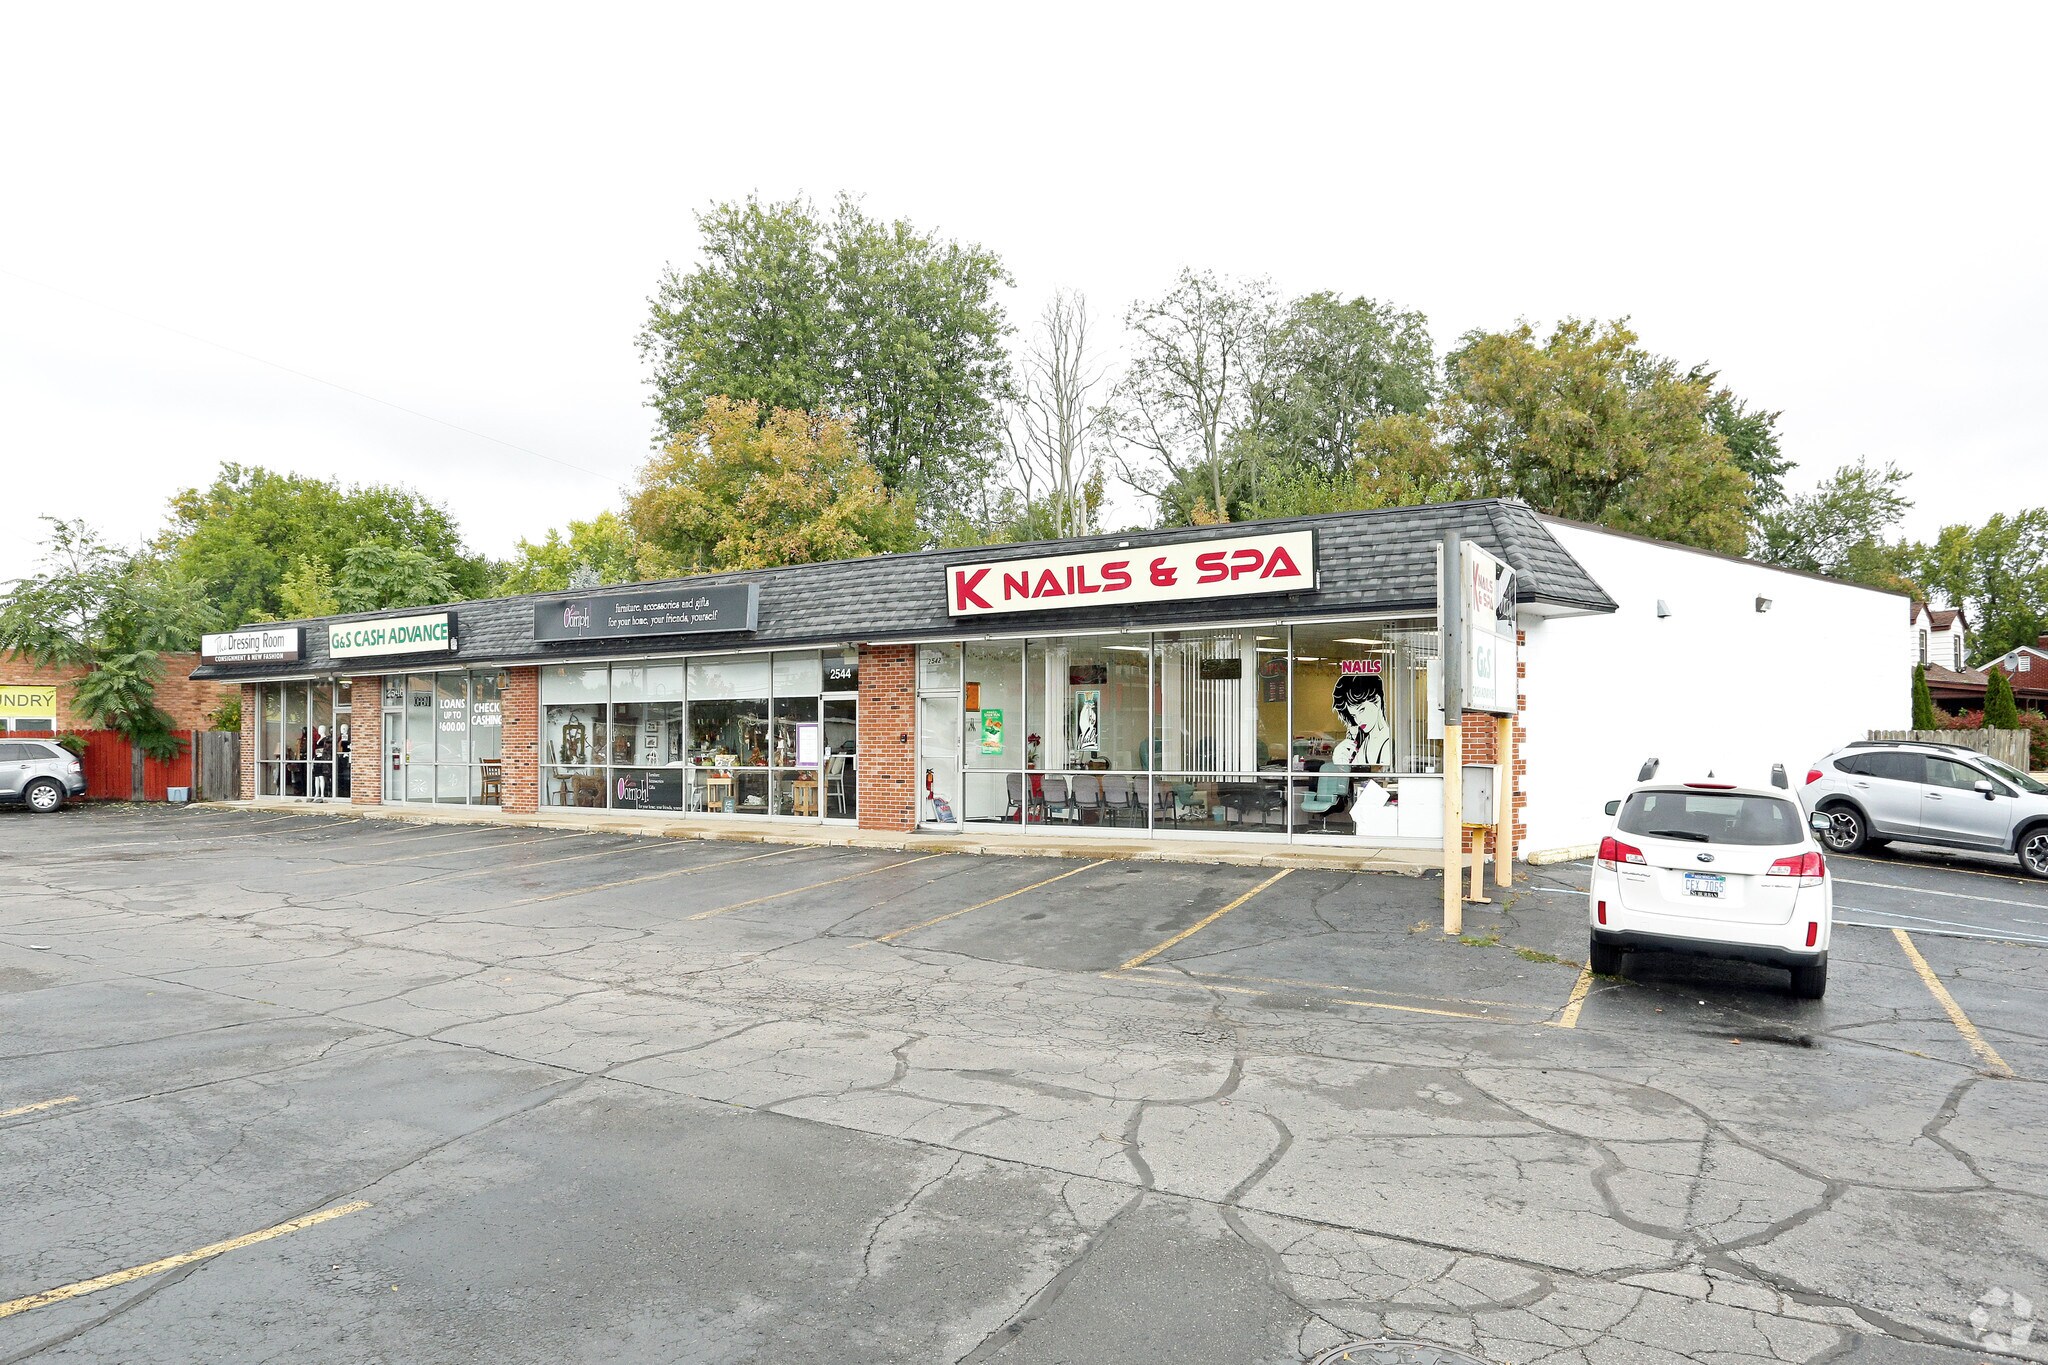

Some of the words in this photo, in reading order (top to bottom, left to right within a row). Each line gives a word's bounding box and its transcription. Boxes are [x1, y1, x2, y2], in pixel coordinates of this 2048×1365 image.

[955, 568, 994, 611] K
[1003, 560, 1132, 601] NAILS
[1149, 556, 1178, 588] &
[1196, 546, 1302, 585] SPA
[1478, 573, 1493, 594] NAILS
[643, 599, 680, 612] accessories
[681, 598, 694, 609] and
[694, 597, 710, 610] gifts
[608, 616, 617, 627] for
[616, 618, 630, 629] your
[650, 614, 664, 628] your
[690, 610, 719, 626] yourself
[228, 634, 260, 652] Dressing
[262, 632, 284, 648] Room
[332, 632, 352, 648] G&S
[354, 628, 386, 647] CASH
[388, 623, 448, 644] ADVANCE
[214, 654, 246, 662] CONSIGNMENT
[1342, 660, 1382, 673] NAILS
[830, 668, 852, 680] 2544
[440, 699, 466, 709] LOANS
[474, 702, 500, 713] CHECK
[440, 722, 466, 732] $600.00
[1686, 880, 1700, 890] CEX
